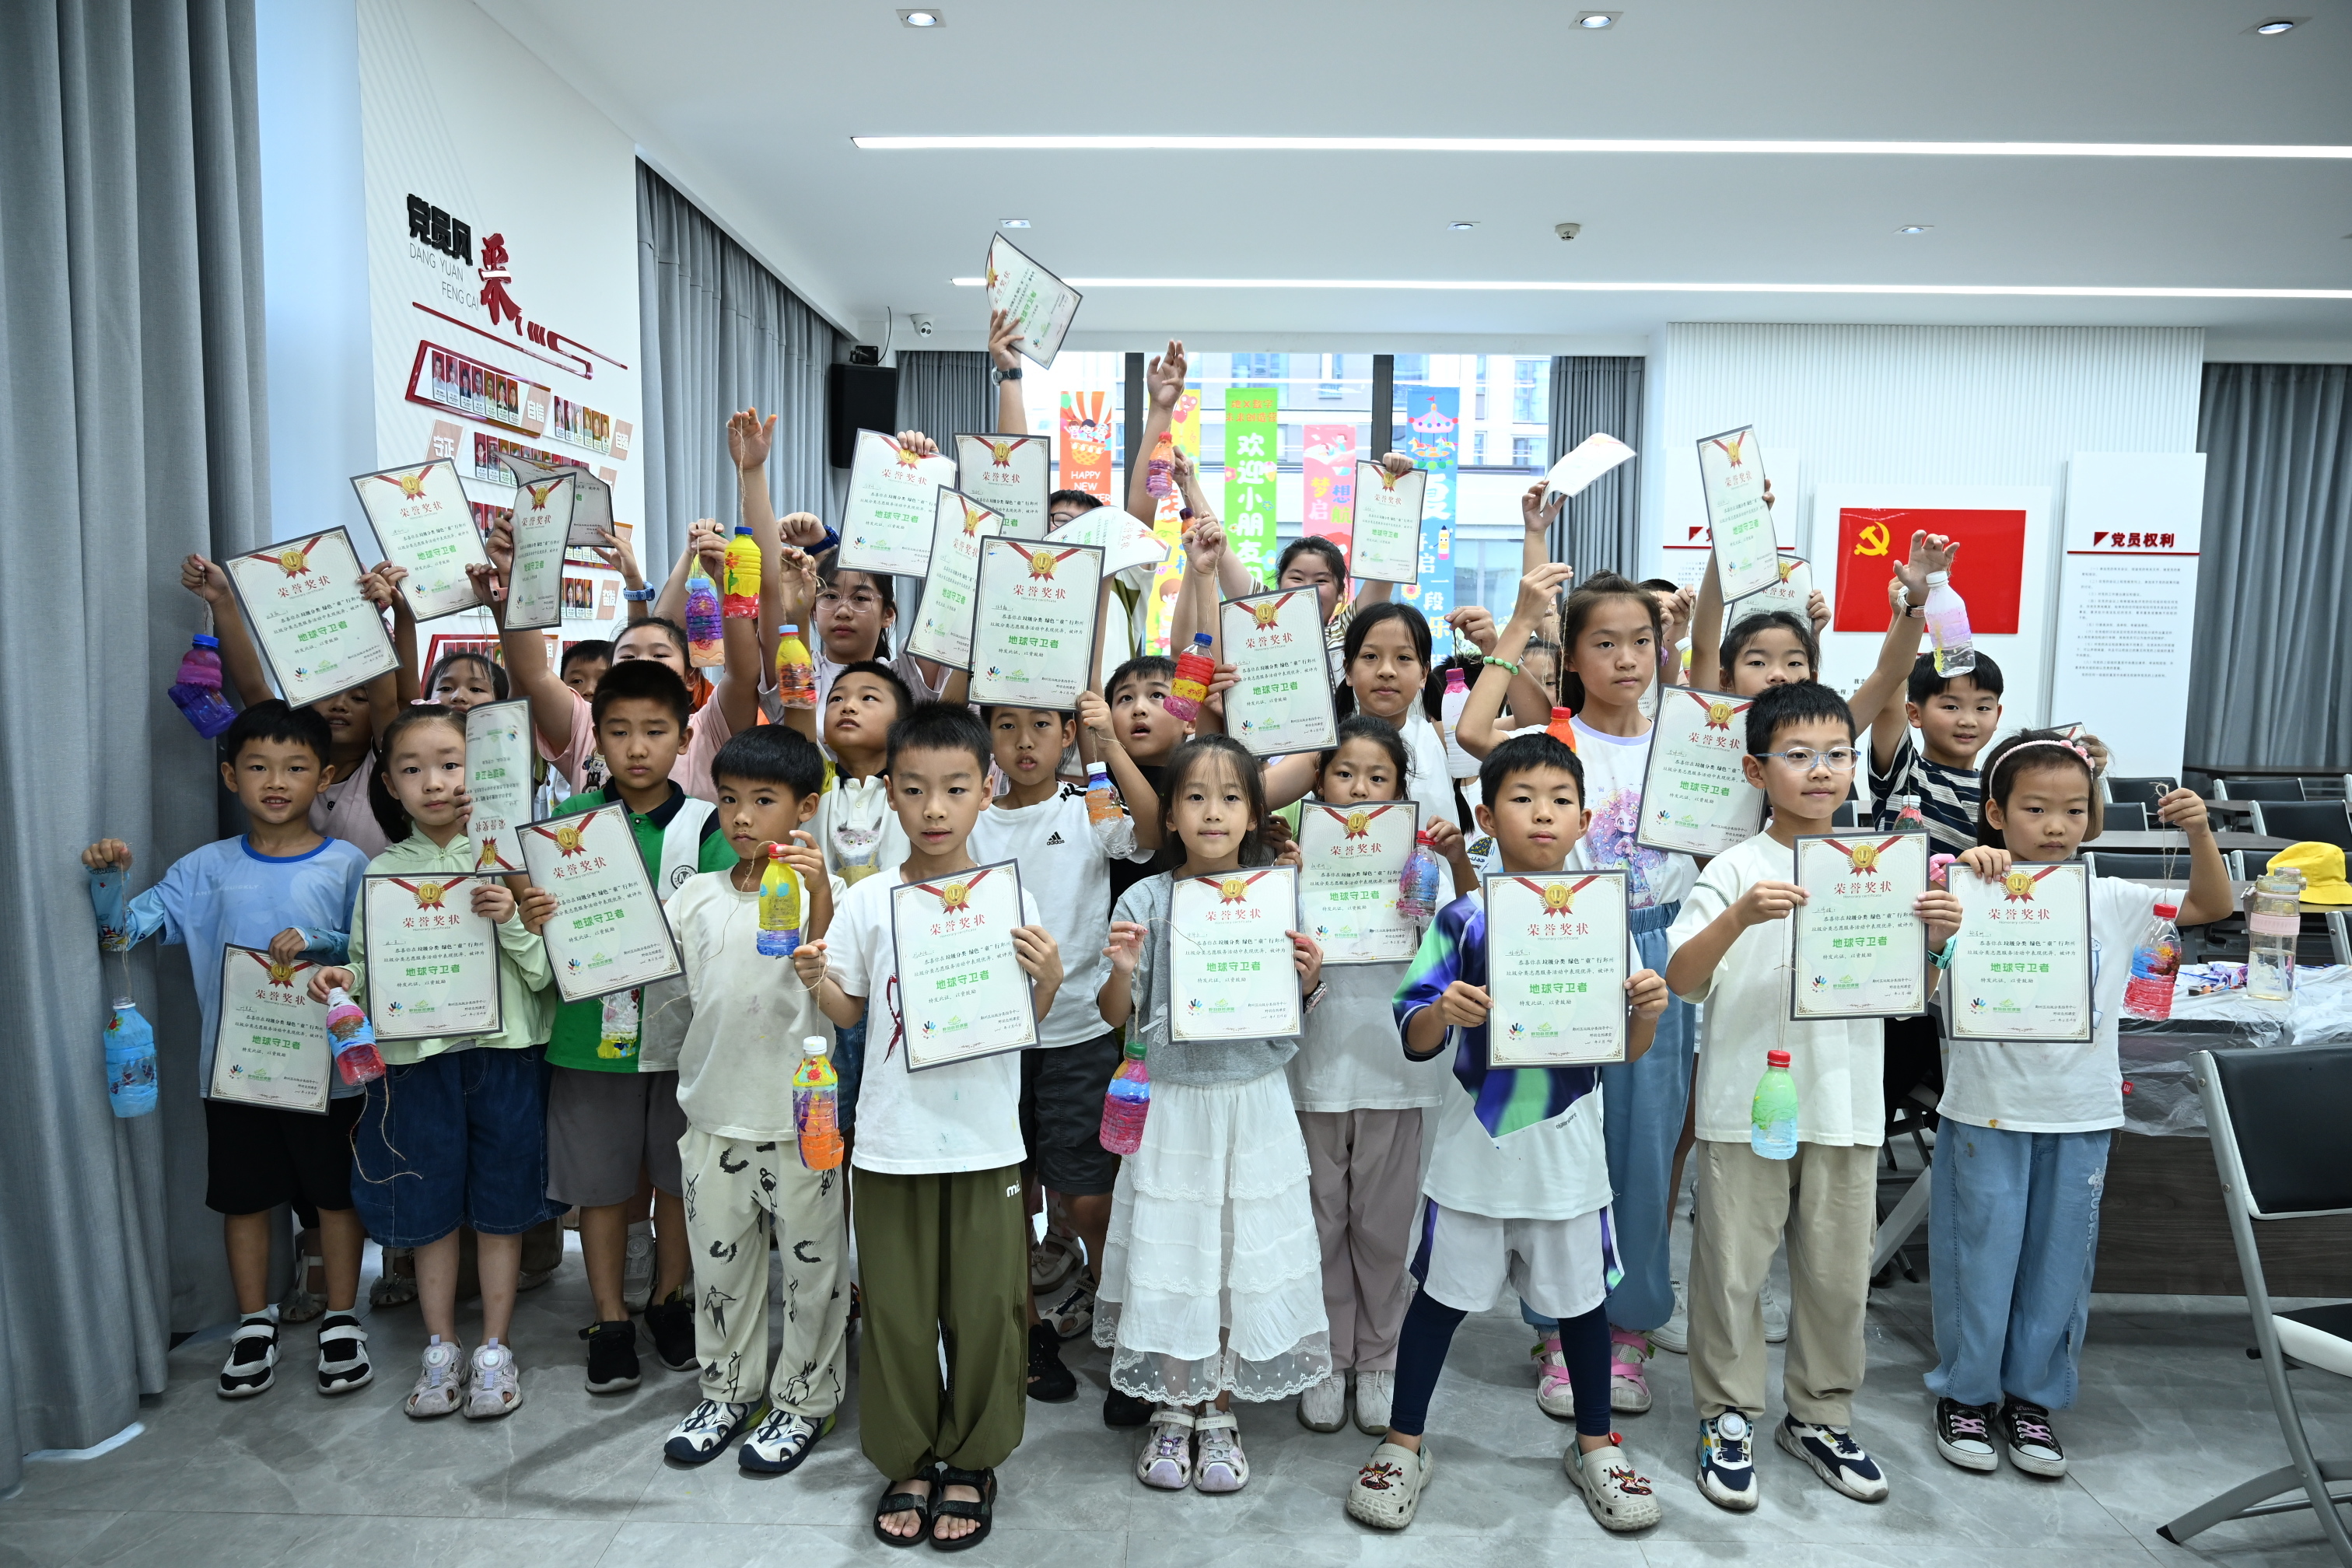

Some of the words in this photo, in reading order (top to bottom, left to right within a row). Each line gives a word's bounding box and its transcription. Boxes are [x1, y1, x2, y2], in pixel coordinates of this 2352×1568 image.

[410, 243, 436, 268] DANG
[439, 257, 464, 282] YUAN
[442, 282, 464, 304] FENG
[466, 293, 480, 311] CAI
[1226, 412, 1277, 422] 未来创造营
[1070, 470, 1101, 481] HAPPY
[1074, 481, 1097, 492] NEW
[1311, 477, 1351, 503] 梦想
[859, 497, 933, 513] 垃圾分类志愿服务活动中表现优异，被
[1309, 499, 1352, 524] 启航
[874, 509, 919, 523] 地球守卫者
[2111, 532, 2175, 548] 党员权利
[275, 574, 331, 599] 荣誉奖状
[1013, 584, 1066, 600] 荣誉奖状
[296, 620, 348, 642] 地球守卫者
[1008, 635, 1059, 648] 地球守卫者
[1244, 632, 1293, 649] 荣誉奖状
[1238, 666, 1318, 682] 圾分类志愿服务活动中表现优异，被评为
[1252, 681, 1298, 695] 地球守卫者
[1687, 732, 1741, 750] 荣誉奖状
[1663, 765, 1747, 784] 垃圾分类志愿服务活动中表现优异，被
[1717, 765, 1744, 775] 绿色“童”
[1679, 780, 1730, 796] 地球守卫者
[1330, 842, 1381, 856] 荣誉奖状
[551, 855, 607, 880] 荣誉奖状
[1834, 880, 1892, 894] 荣誉奖状
[553, 890, 643, 917] 圾分类志愿服务活动中表现优异，被评为
[1330, 891, 1379, 901] 地球守卫者
[402, 914, 460, 928] 荣誉奖状
[572, 908, 625, 929] 地球守卫者
[1205, 908, 1262, 921] 荣誉奖状
[1988, 908, 2050, 920] 荣誉奖状
[929, 912, 985, 936] 荣誉奖状
[1527, 922, 1589, 936] 荣誉奖状
[1832, 936, 1887, 948] 地球守卫者
[405, 964, 460, 977] 地球守卫者
[1206, 961, 1261, 971] 地球守卫者
[1990, 962, 2049, 972] 地球守卫者
[936, 969, 989, 990] 地球守卫者
[1529, 982, 1587, 993] 地球守卫者
[255, 988, 306, 1006] 荣誉奖状
[252, 1034, 300, 1050] 地球守卫者
